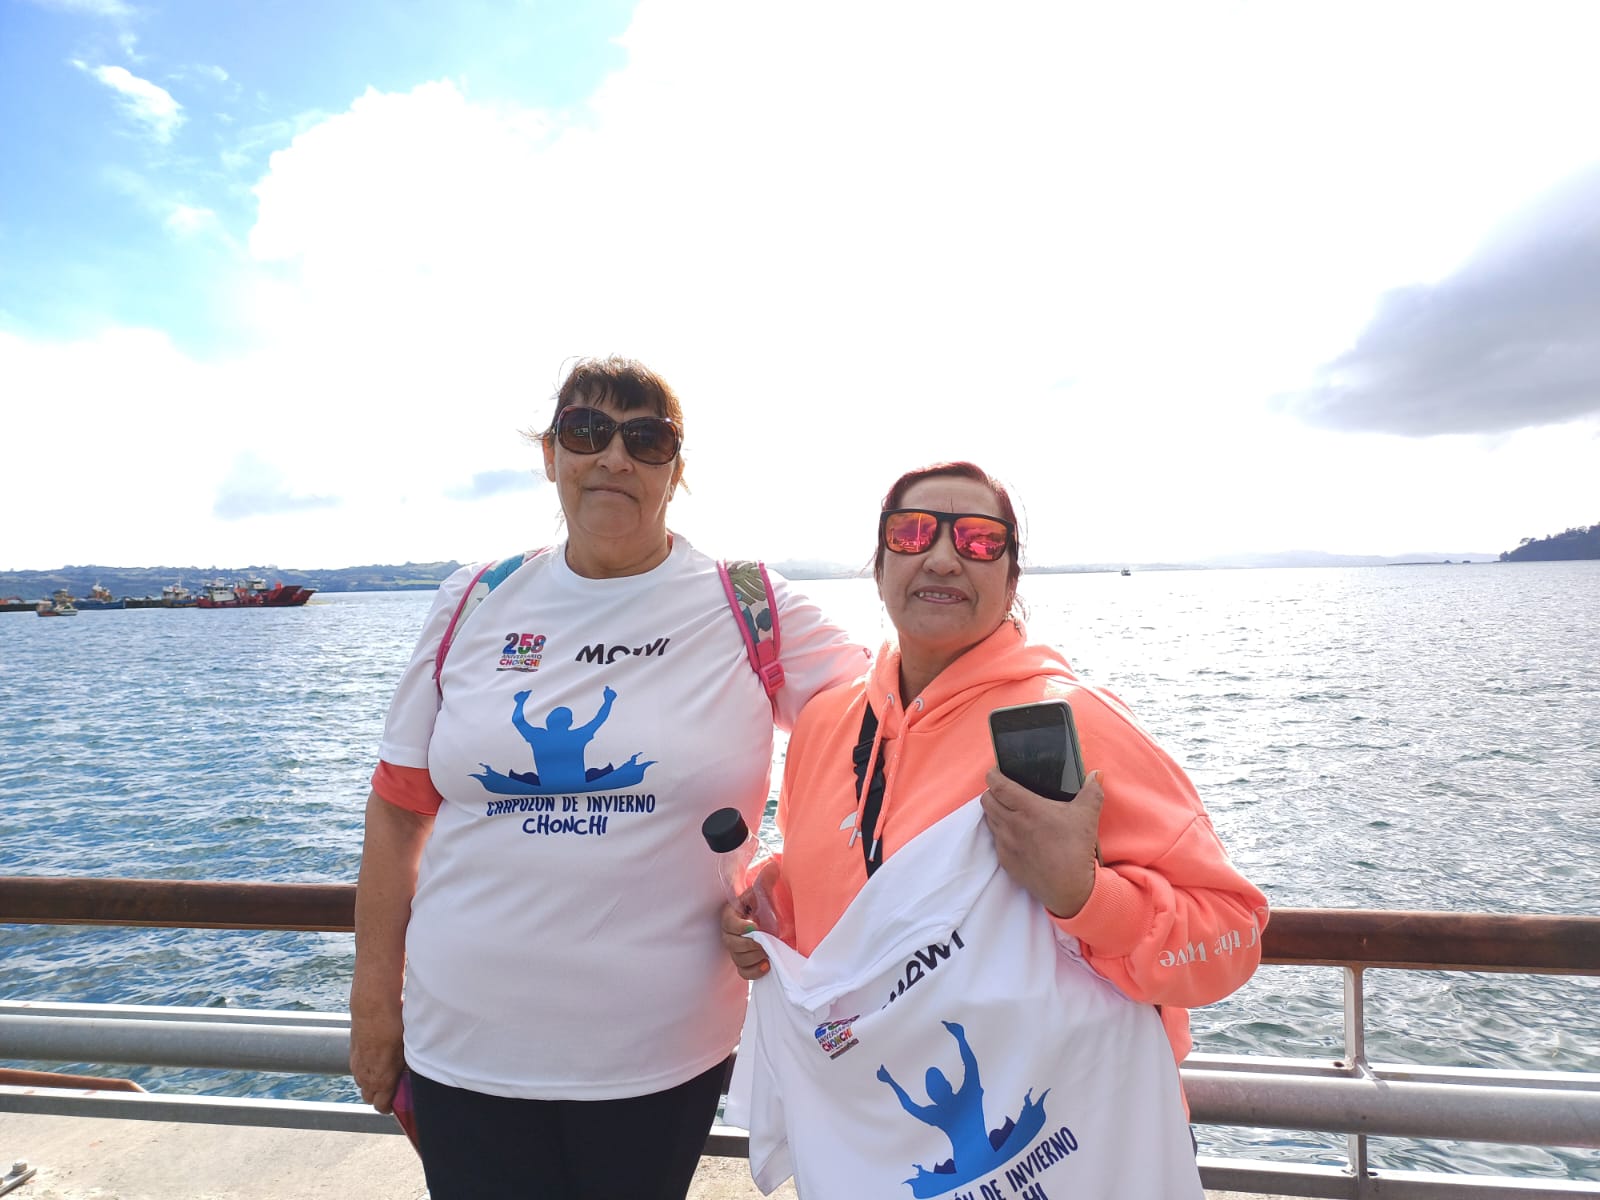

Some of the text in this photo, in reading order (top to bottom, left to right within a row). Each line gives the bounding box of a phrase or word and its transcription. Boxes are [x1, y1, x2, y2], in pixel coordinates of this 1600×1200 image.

[502, 632, 546, 654] 258
[562, 796, 579, 812] DE
[587, 794, 656, 813] INVIERNO
[522, 814, 608, 835] CHONCHI
[1005, 1126, 1078, 1192] INVIERNO
